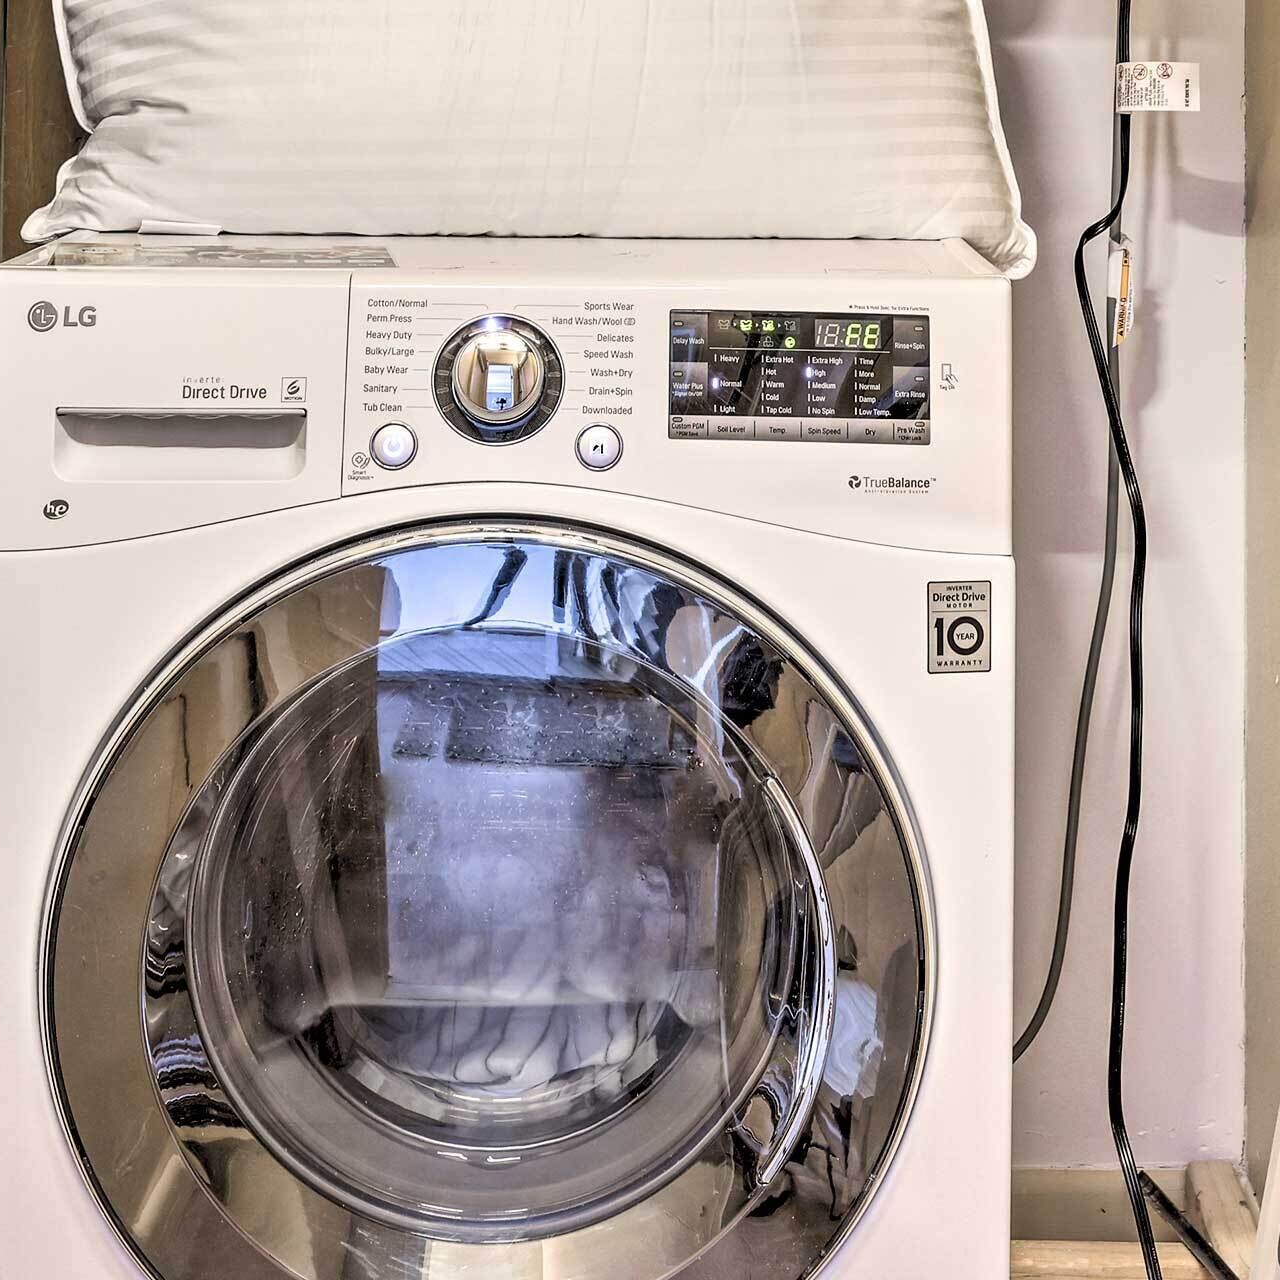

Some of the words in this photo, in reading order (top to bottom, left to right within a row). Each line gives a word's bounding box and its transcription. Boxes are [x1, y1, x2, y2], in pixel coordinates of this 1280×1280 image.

[367, 298, 428, 307] Cotton/Normal
[584, 302, 610, 311] Sports
[612, 302, 634, 311] Wear
[63, 305, 97, 327] LG
[367, 314, 387, 322] Perm
[390, 314, 412, 322] Press
[552, 316, 573, 325] Hand
[575, 317, 622, 325] Wash/Wool
[366, 330, 391, 340] Heavy
[393, 331, 412, 340] Duty
[597, 333, 634, 342] Delicates
[673, 337, 687, 345] Delay
[894, 342, 925, 350] Rinse+Spin
[365, 347, 415, 357] Bulky/Large
[583, 350, 608, 359] Speed
[610, 350, 633, 359] Wash
[720, 355, 740, 363] Heavy
[829, 357, 843, 366] High
[364, 365, 385, 375] Baby
[387, 365, 408, 374] Wear
[590, 368, 633, 378] Wash+Dry
[812, 369, 826, 378] High
[363, 384, 398, 394] Sanitary
[672, 382, 690, 390] Water
[859, 383, 880, 391] Normal
[182, 385, 225, 399] Direct
[230, 385, 267, 399] Drive
[589, 387, 633, 397] Drain+Spin
[859, 396, 876, 404] Damp
[363, 403, 378, 411] Tub
[379, 403, 402, 411] Clean
[582, 406, 633, 415] Downloaded
[720, 405, 736, 414] Light
[766, 406, 777, 414] Tap
[778, 406, 792, 414] Cold
[769, 427, 786, 435] Temp
[865, 428, 876, 436] Dry
[933, 593, 960, 601] Direct
[962, 592, 986, 601] Drive
[934, 616, 984, 656] 10
